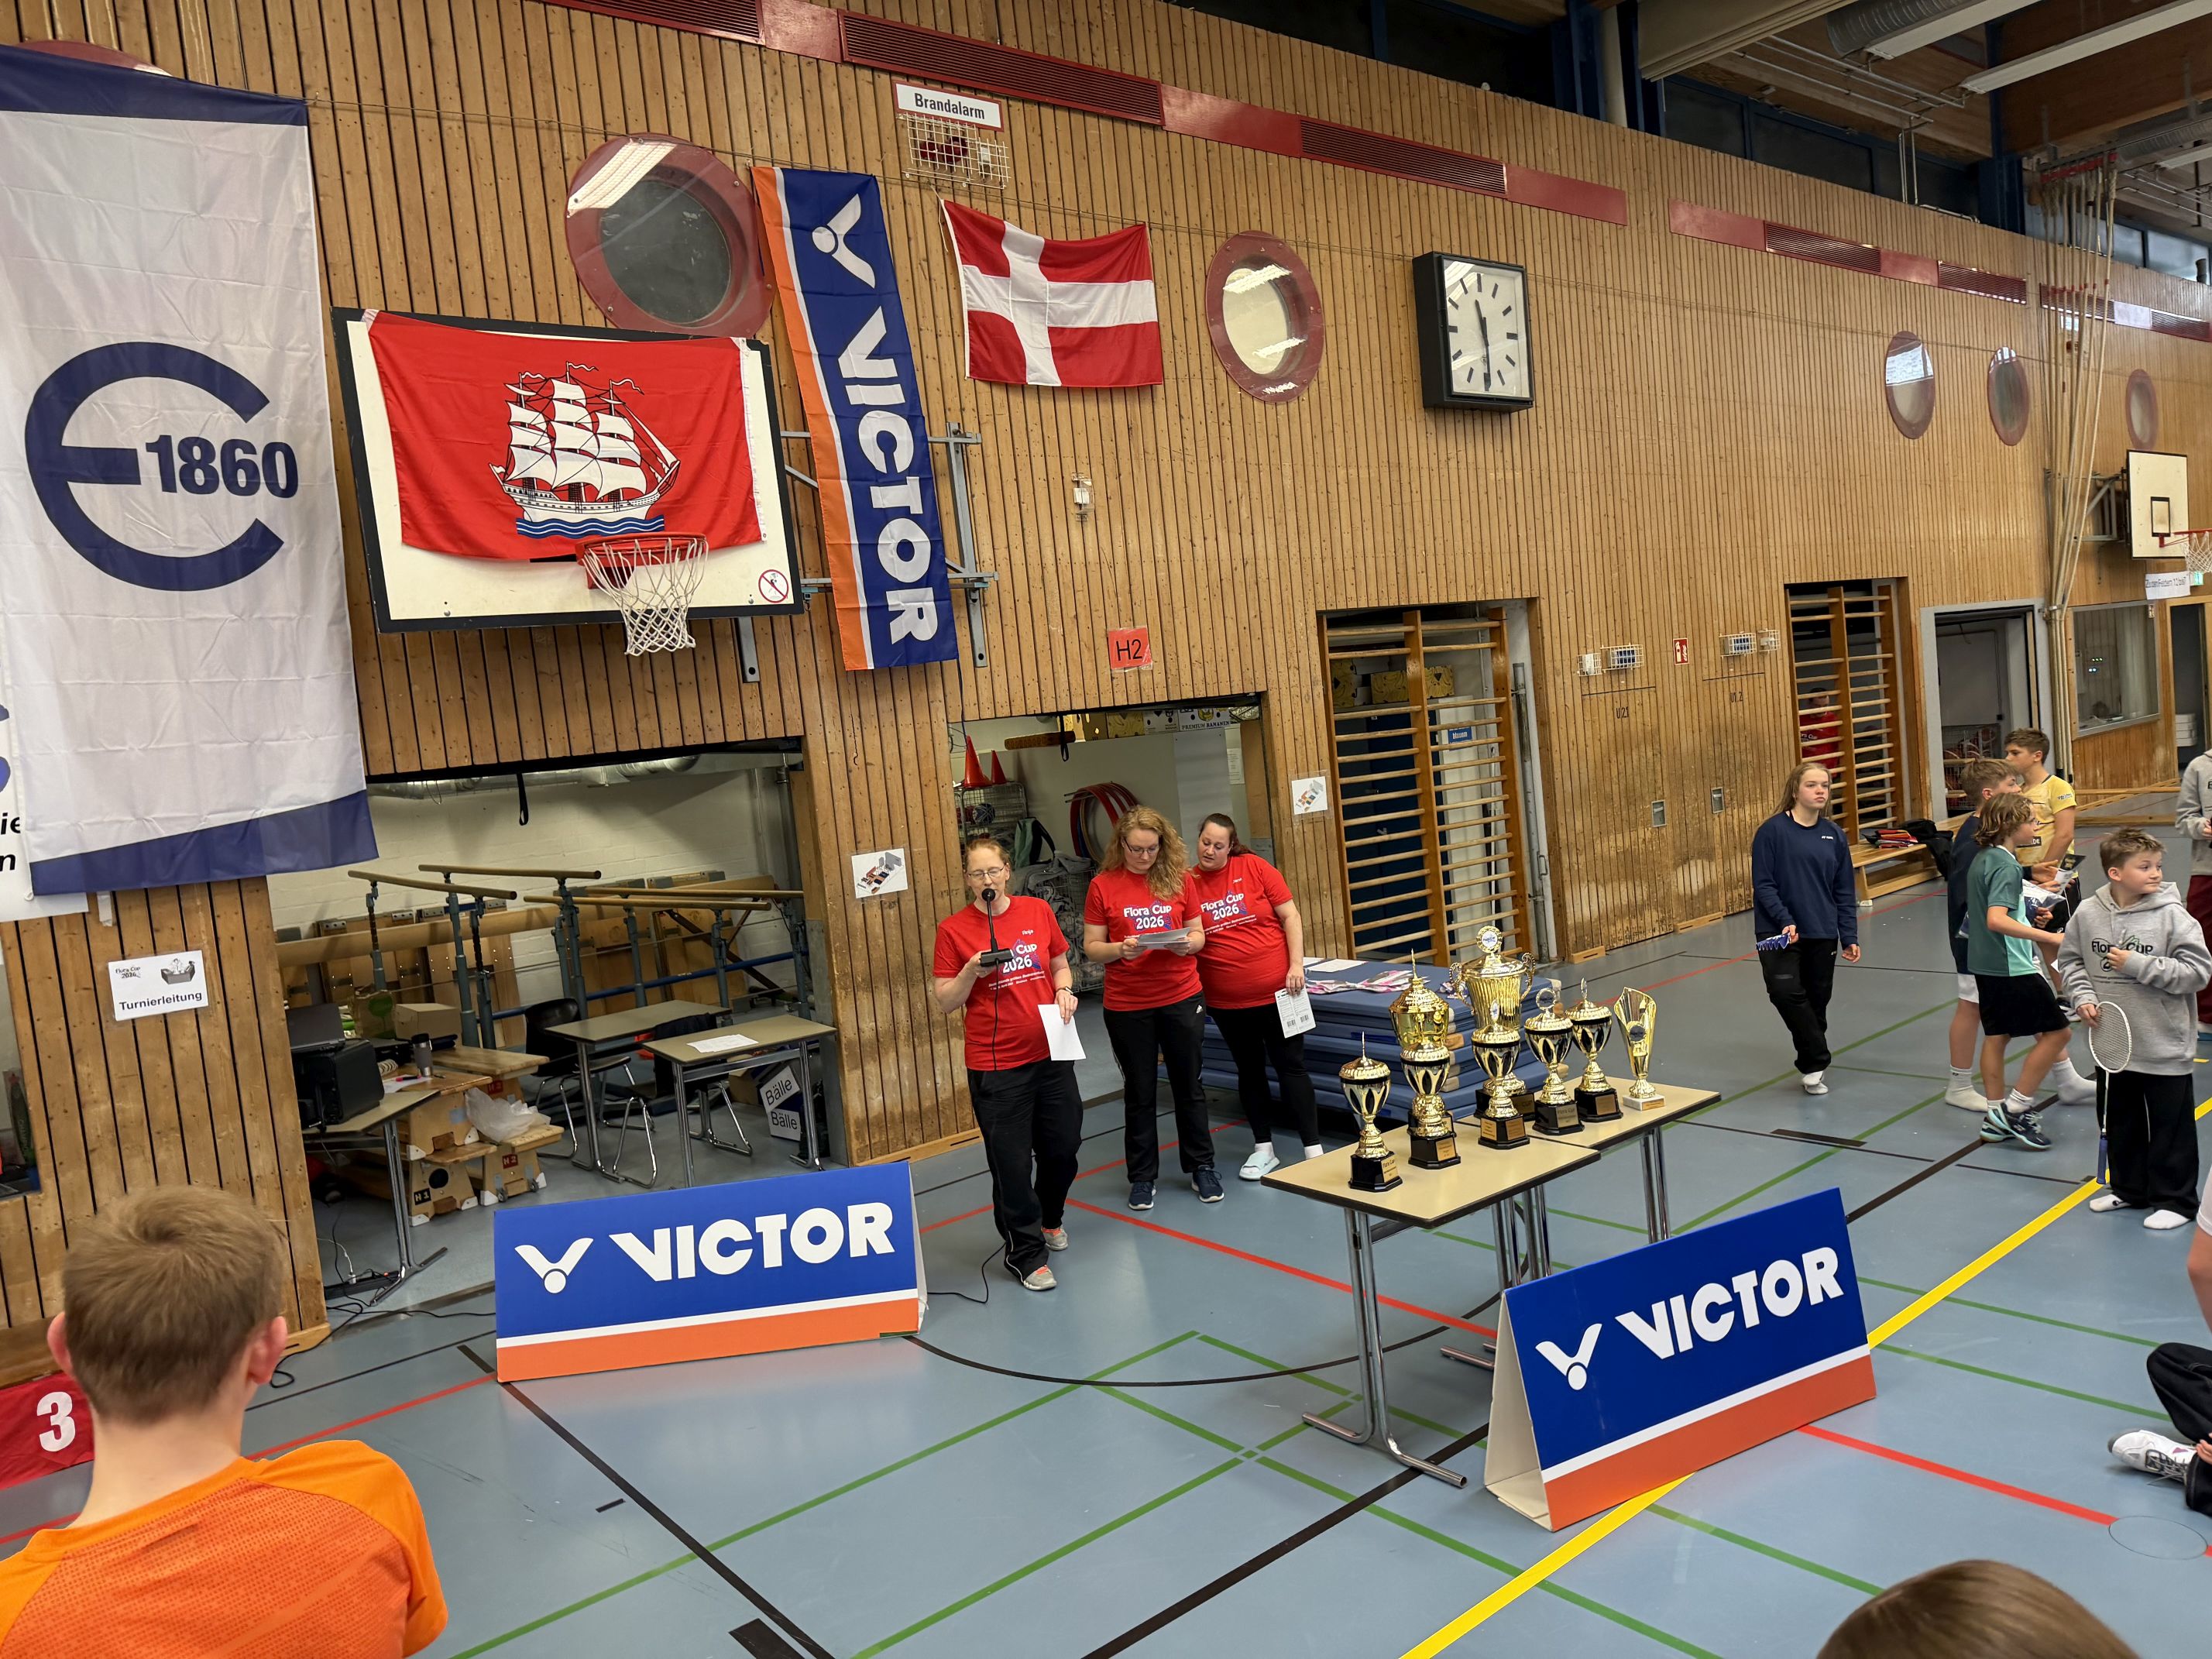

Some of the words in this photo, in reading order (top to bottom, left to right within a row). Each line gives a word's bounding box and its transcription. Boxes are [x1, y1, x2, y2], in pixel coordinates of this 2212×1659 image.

[914, 92, 985, 119] Brandalarm
[145, 434, 299, 498] 1860
[837, 306, 938, 644] VICTOR
[1116, 639, 1142, 661] H2
[1124, 907, 1149, 918] Flora
[1152, 905, 1172, 914] Cup
[1200, 900, 1224, 912] Flora
[1226, 893, 1244, 904] Cup
[1212, 903, 1239, 921] 2026
[1135, 915, 1164, 930] 2026
[1015, 944, 1037, 954] Cup
[1002, 954, 1032, 973] 2026
[119, 992, 202, 1011] Turnierleitung
[765, 1079, 792, 1106] Bälle
[771, 1111, 798, 1130] Bälle
[609, 1202, 895, 1282] VICTOR
[1615, 1246, 1844, 1359] VICTOR
[36, 1391, 76, 1452] 3
